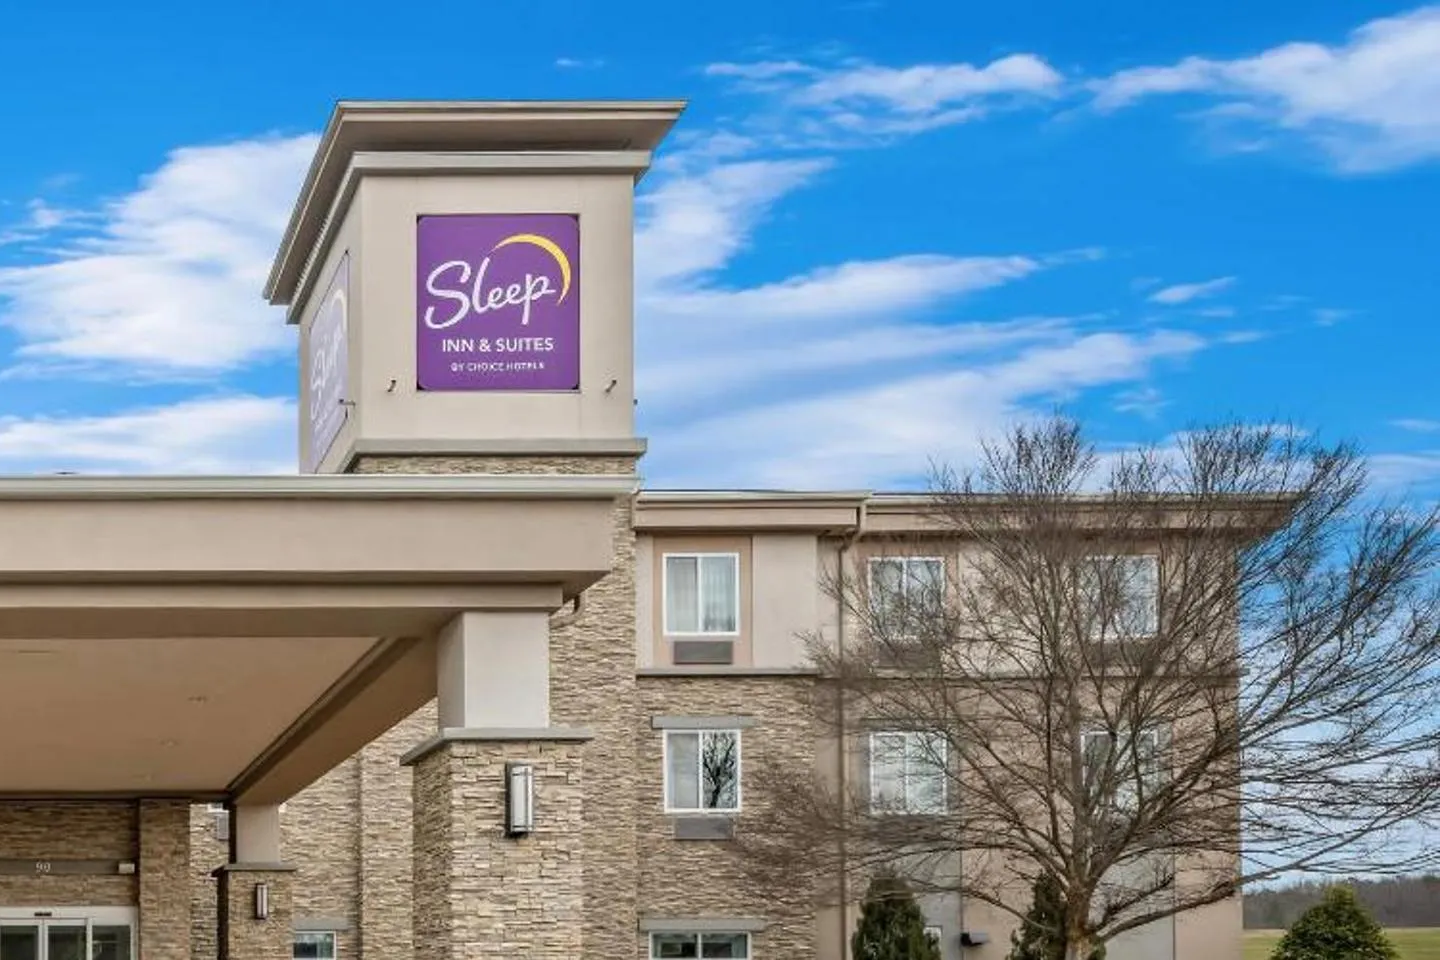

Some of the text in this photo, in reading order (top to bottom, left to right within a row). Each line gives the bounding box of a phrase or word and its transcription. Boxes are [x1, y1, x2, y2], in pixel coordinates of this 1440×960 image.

[424, 256, 556, 329] Sleep
[442, 337, 554, 353] INN & SUITES
[450, 362, 464, 372] BY
[468, 362, 504, 372] CHOICE
